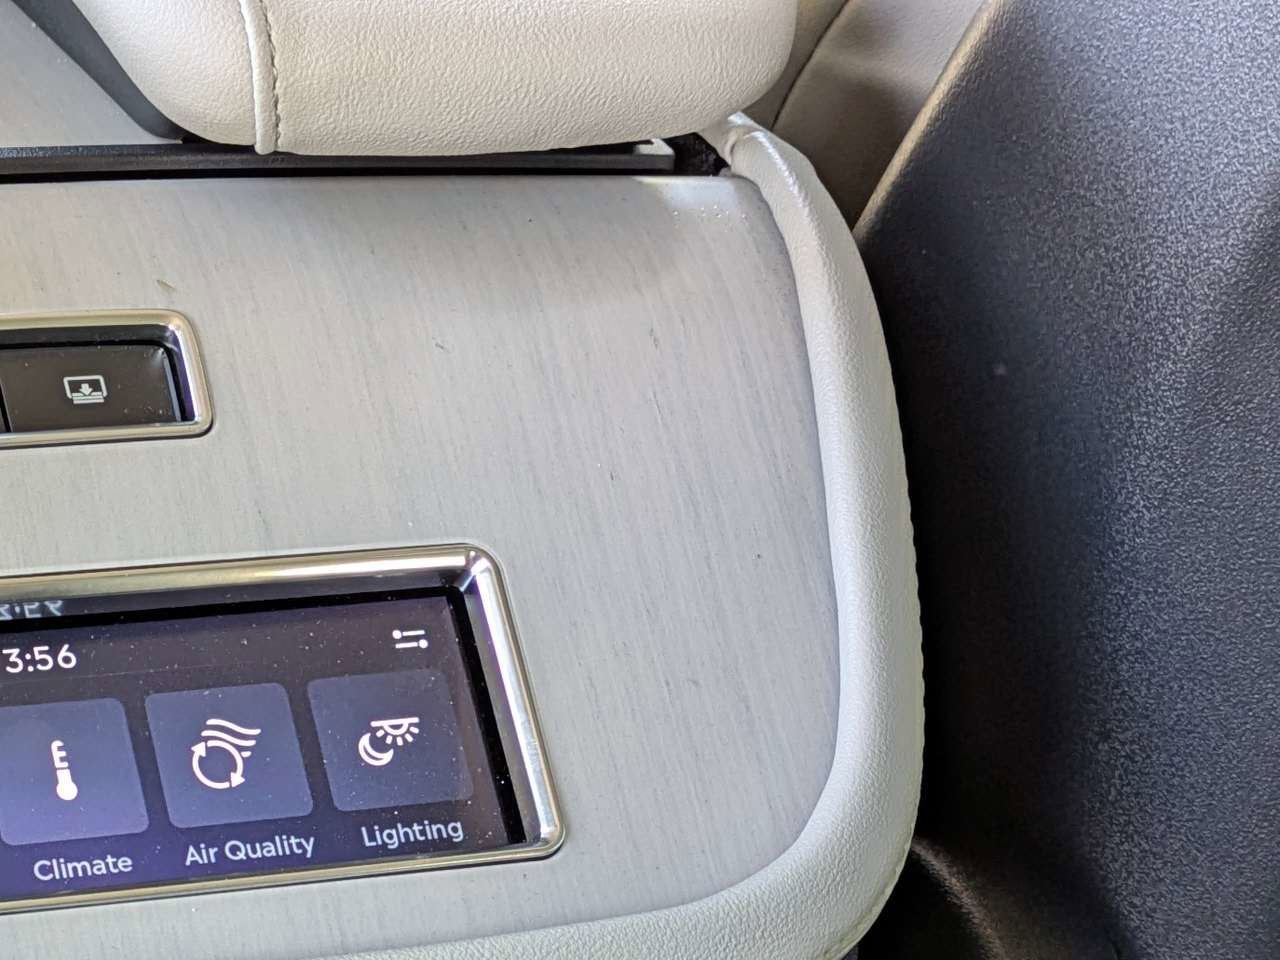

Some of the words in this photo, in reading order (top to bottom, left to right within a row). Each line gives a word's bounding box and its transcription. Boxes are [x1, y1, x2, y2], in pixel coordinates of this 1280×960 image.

[1, 643, 78, 674] 3:56
[360, 819, 464, 849] Lighting
[185, 844, 218, 866] Air
[224, 834, 316, 860] Quality
[33, 854, 133, 881] Climate
